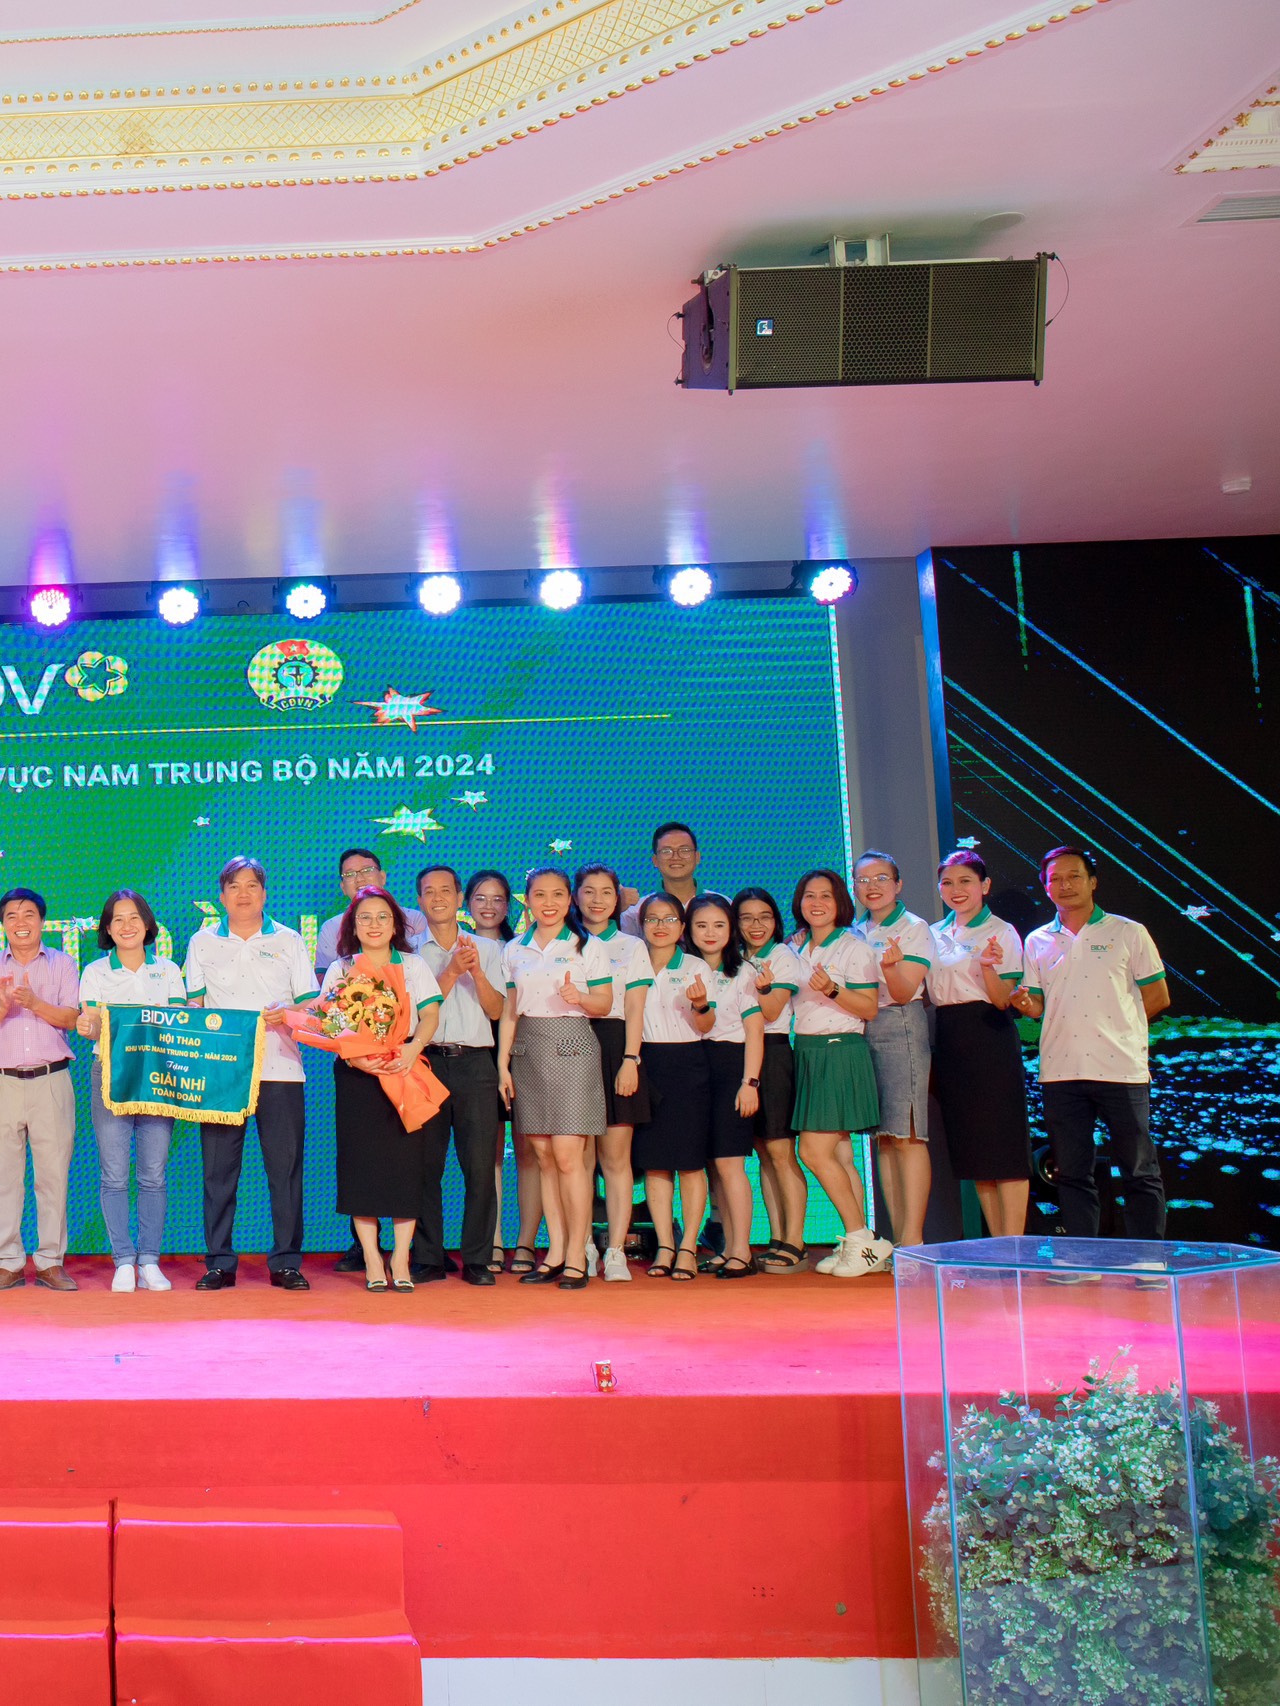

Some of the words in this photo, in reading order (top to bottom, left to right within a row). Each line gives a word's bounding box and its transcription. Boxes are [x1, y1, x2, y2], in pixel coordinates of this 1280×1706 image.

[63, 762, 140, 787] NAM
[148, 760, 263, 786] TRUNG
[271, 754, 318, 786] BỘ
[327, 752, 406, 780] NĂM
[414, 753, 497, 777] 2024
[141, 1009, 176, 1026] BIDV
[159, 1033, 174, 1044] HỘI
[176, 1036, 201, 1046] THAO
[138, 1045, 151, 1053] VỰC
[152, 1046, 166, 1054] NAM
[167, 1049, 188, 1057] TRUNG
[190, 1051, 200, 1059] BỘ
[205, 1052, 220, 1060] NĂM
[149, 1071, 177, 1088] GIẢI
[180, 1076, 206, 1091] NHÌ
[152, 1087, 175, 1098] TOÀN
[176, 1092, 202, 1103] ĐOÀN
